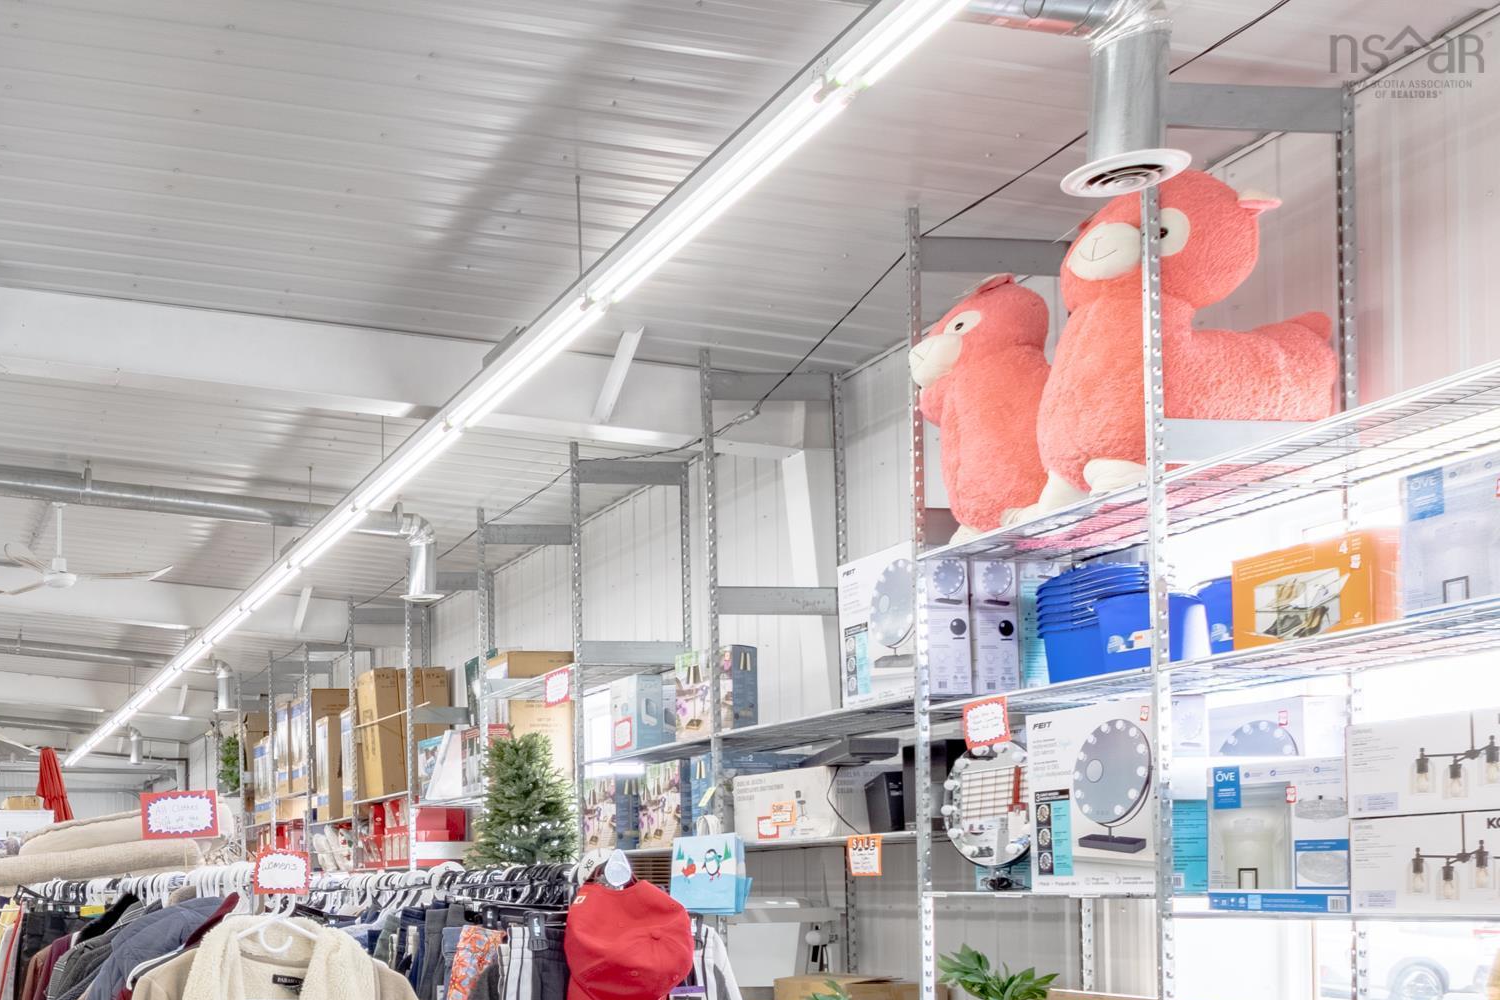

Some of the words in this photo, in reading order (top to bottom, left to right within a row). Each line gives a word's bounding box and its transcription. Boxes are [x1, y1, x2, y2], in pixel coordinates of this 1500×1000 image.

[1032, 721, 1053, 730] FEIT
[852, 839, 875, 851] SALE
[584, 859, 594, 871] XS
